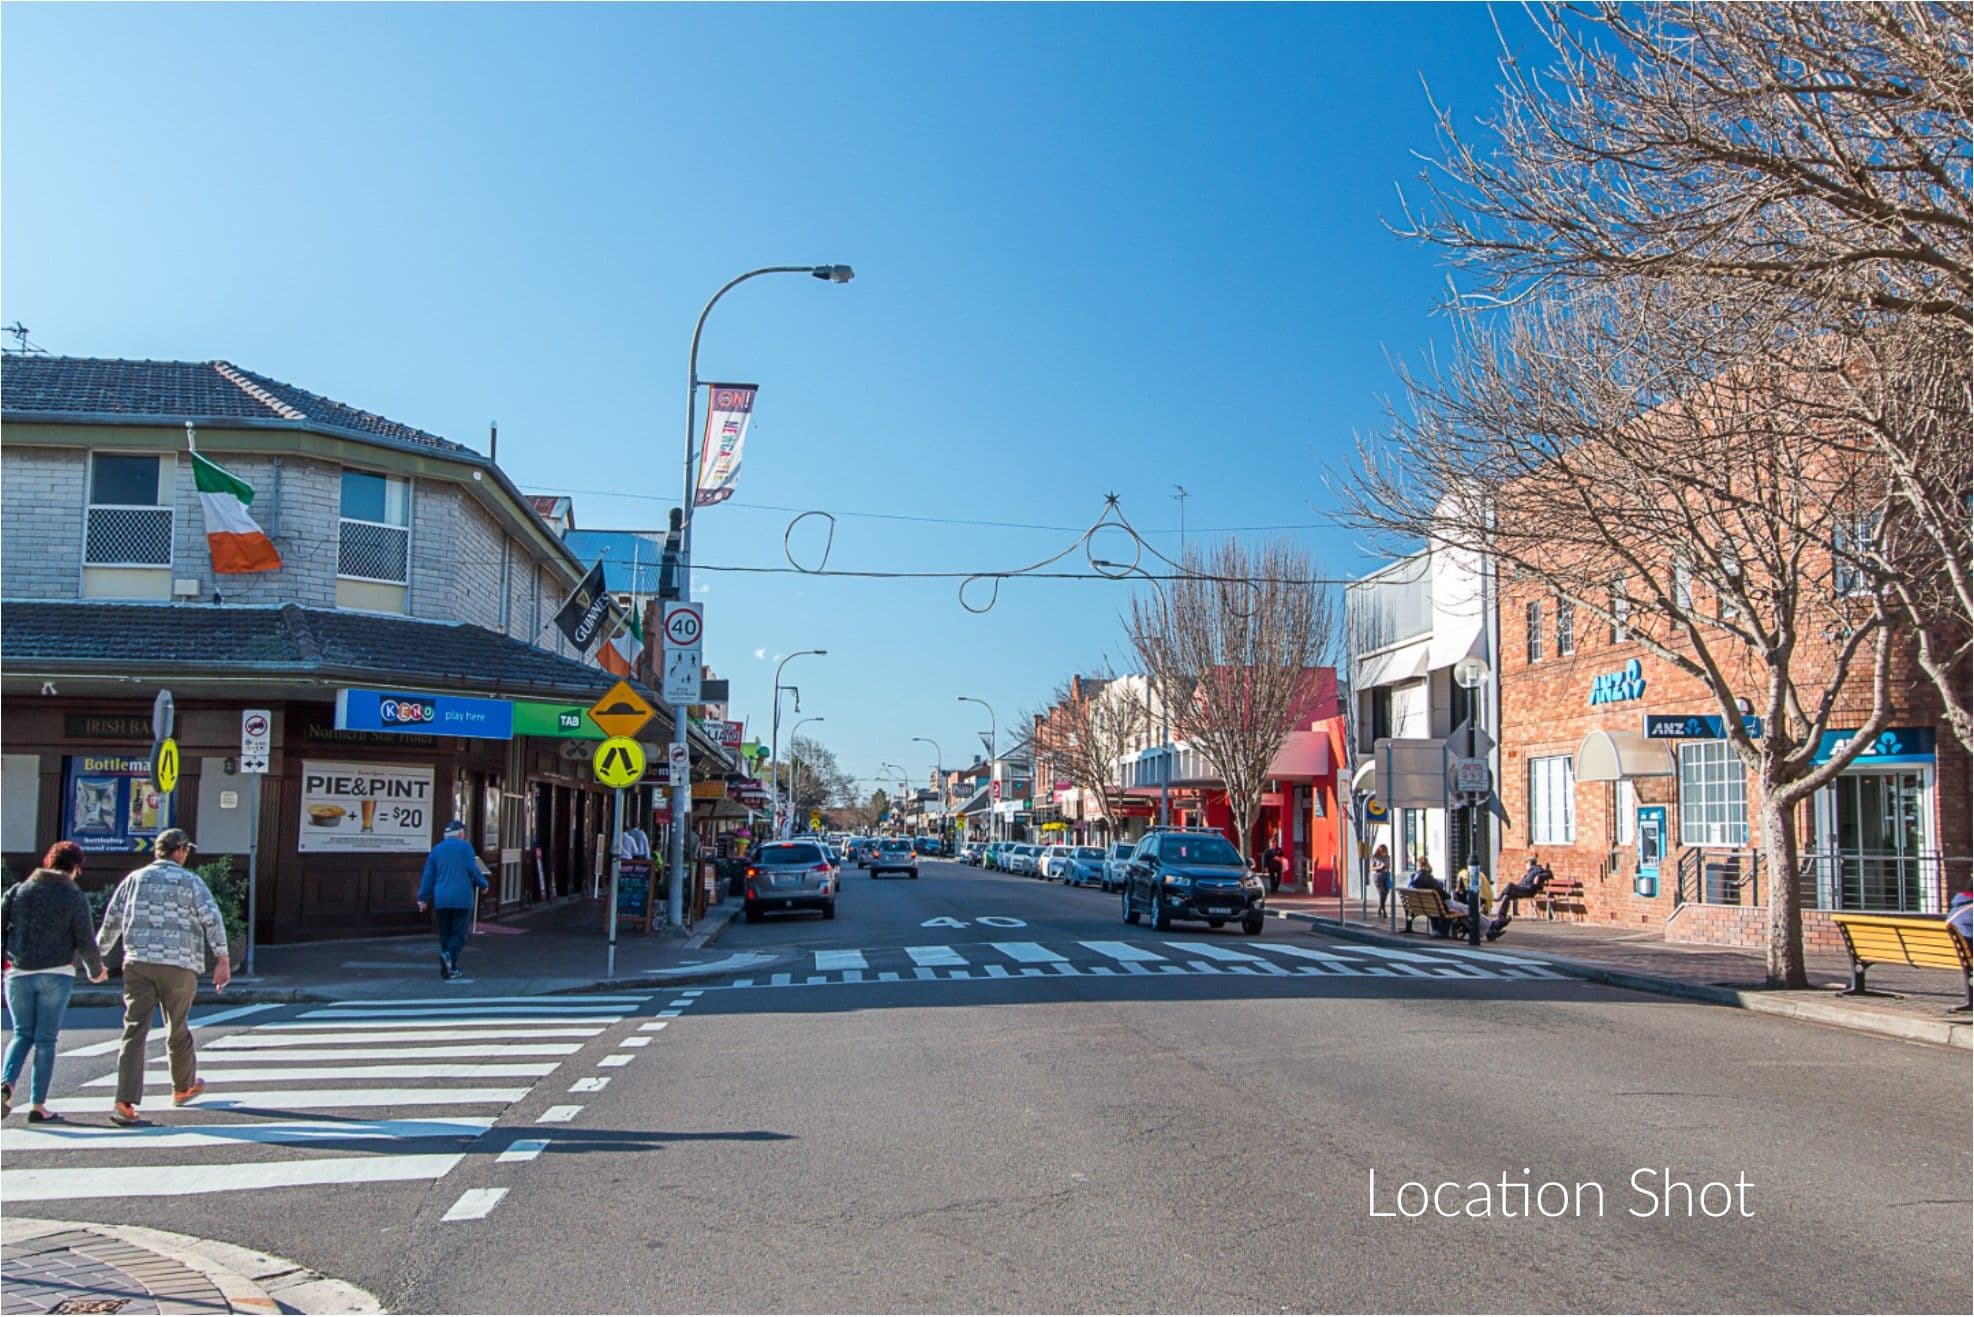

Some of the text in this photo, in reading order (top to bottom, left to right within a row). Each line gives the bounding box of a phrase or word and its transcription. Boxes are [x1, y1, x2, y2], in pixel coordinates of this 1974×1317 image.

[671, 619, 697, 636] 40
[1590, 672, 1626, 705] ANZ
[381, 700, 435, 722] KENO
[445, 711, 486, 722] play here
[86, 719, 151, 734] IRISH BA
[560, 715, 580, 727] TAB
[1651, 722, 1685, 736] ANZ
[84, 758, 151, 772] Bottlema
[305, 775, 430, 799] PIE&PINT
[392, 806, 423, 829] $20
[920, 916, 1028, 929] 40
